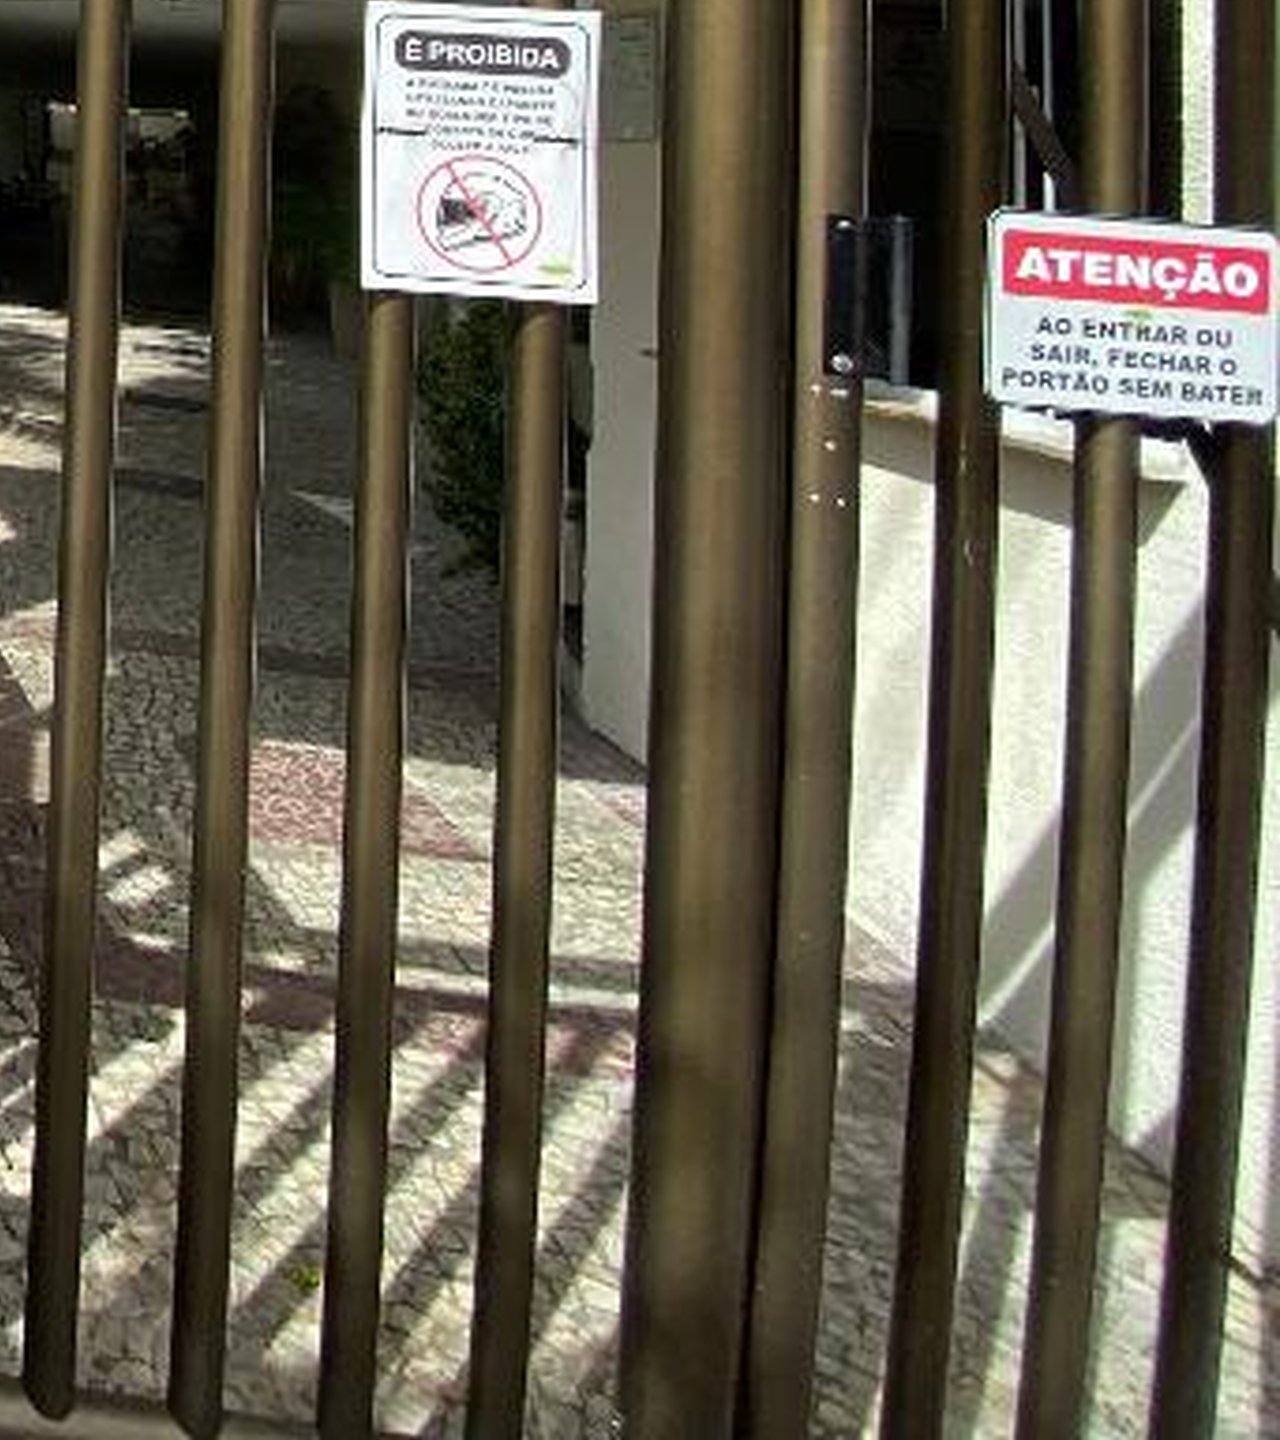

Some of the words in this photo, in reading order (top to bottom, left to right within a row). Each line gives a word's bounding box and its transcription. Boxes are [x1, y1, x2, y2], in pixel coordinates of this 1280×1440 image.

[428, 38, 559, 69] PROIBIDA
[1016, 246, 1259, 300] ATENÇÃO
[1037, 317, 1072, 335] AO
[1083, 320, 1189, 345] ENTRAR
[1196, 329, 1233, 349] OU
[1030, 343, 1097, 366] SAIR,
[1106, 348, 1212, 375] FECHAR
[1219, 359, 1237, 376] O
[1002, 367, 1109, 395] PORTÃO
[1118, 377, 1173, 398] SEM
[1181, 384, 1262, 406] BATER
